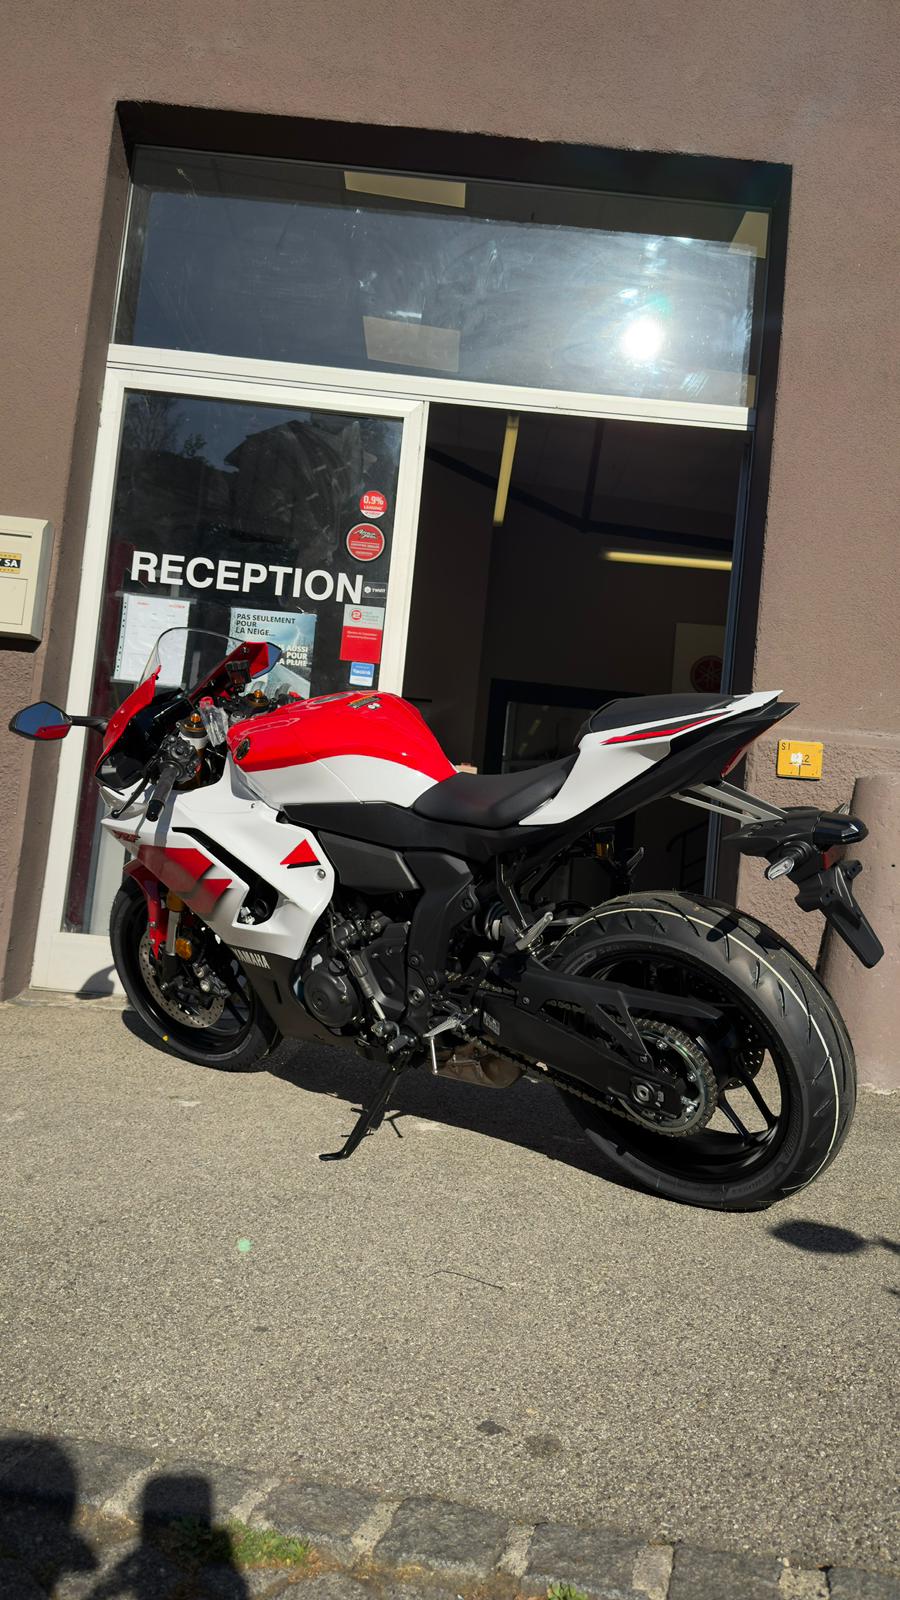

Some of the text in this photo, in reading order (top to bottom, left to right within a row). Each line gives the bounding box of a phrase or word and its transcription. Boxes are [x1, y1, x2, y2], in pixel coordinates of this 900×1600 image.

[363, 495, 385, 506] 0.9%
[4, 559, 18, 568] SA
[130, 550, 364, 605] RECEPTION
[236, 613, 296, 624] PAS SEULEMENT
[236, 620, 257, 628] POUR
[235, 627, 246, 635] LA
[287, 645, 309, 653] AUSSI
[286, 651, 308, 661] POUR
[230, 947, 271, 970] YAMAHA
